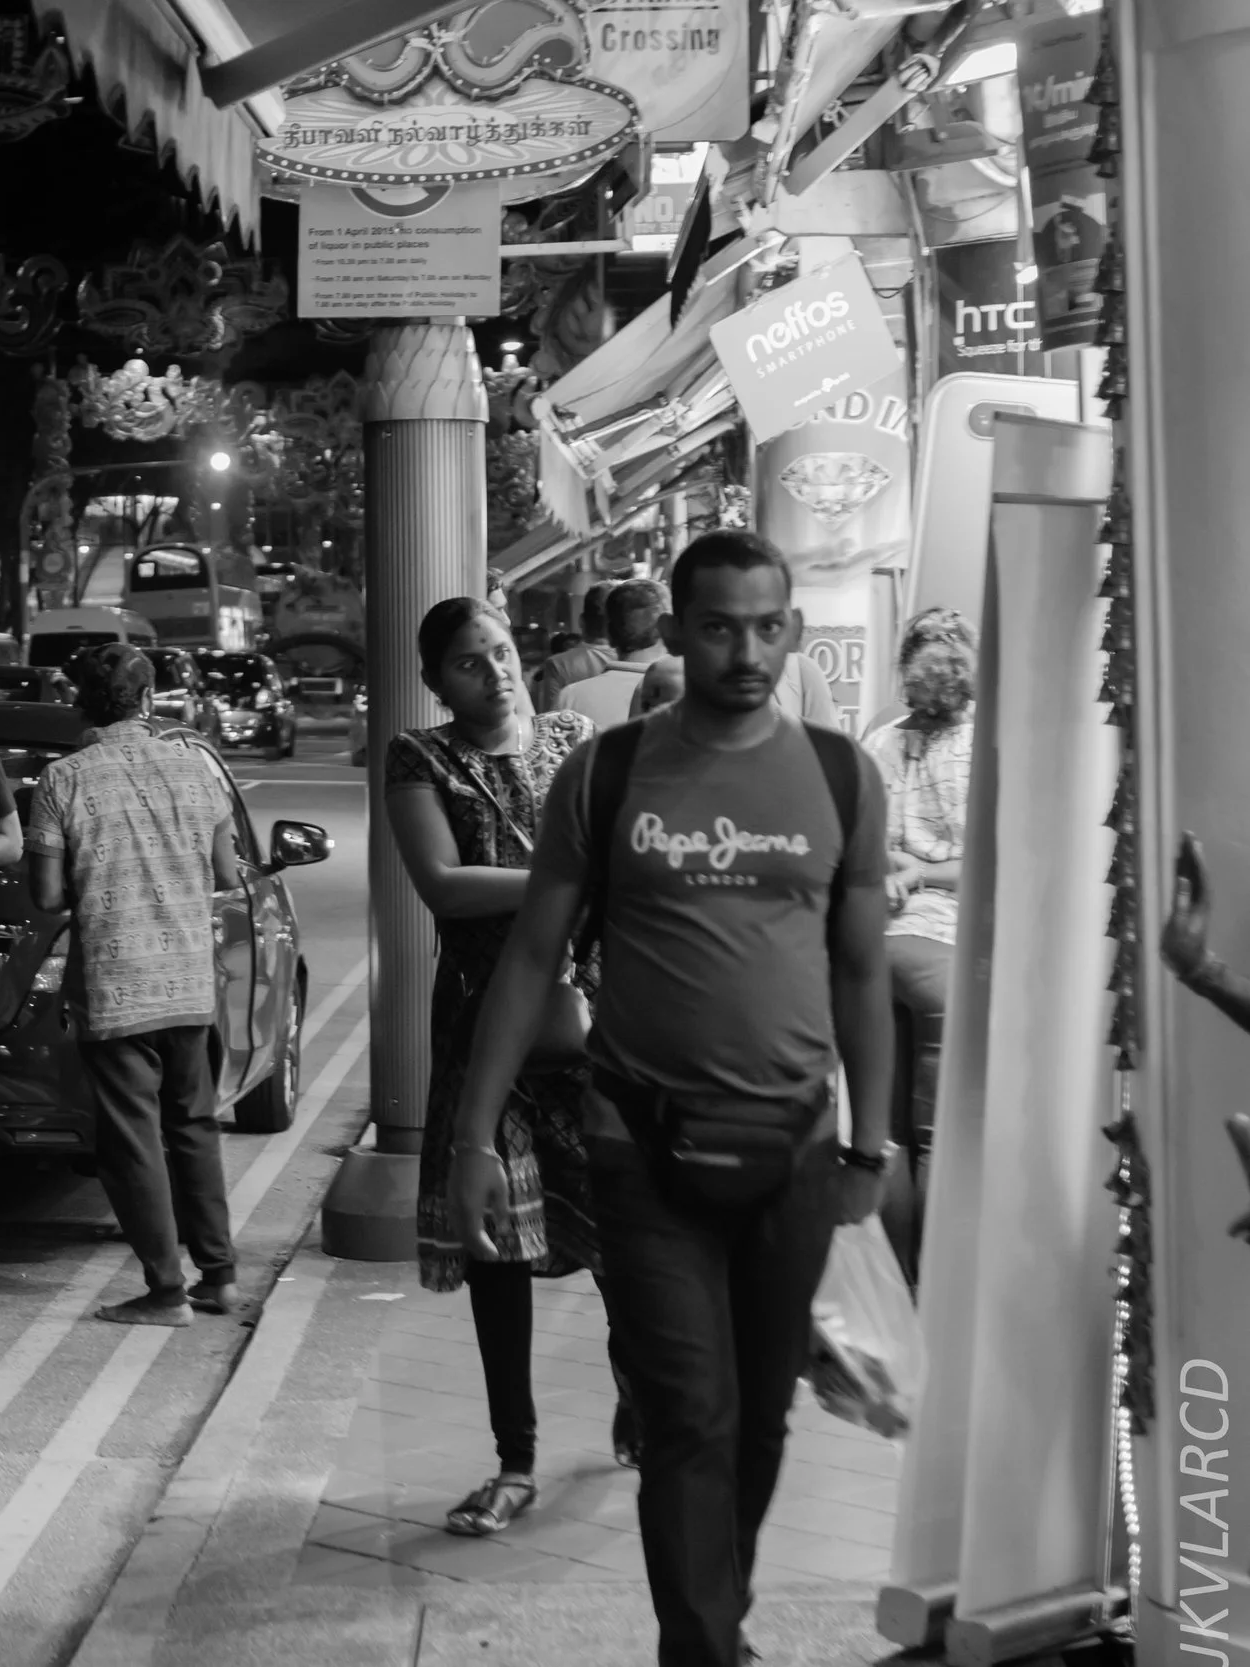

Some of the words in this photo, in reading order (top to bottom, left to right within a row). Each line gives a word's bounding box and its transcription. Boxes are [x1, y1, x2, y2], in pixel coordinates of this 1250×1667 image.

[601, 23, 721, 55] Crossing
[308, 227, 335, 237] From
[337, 227, 343, 236] 1
[345, 226, 369, 238] April
[415, 226, 482, 236] consumption
[308, 241, 318, 250] of
[363, 240, 395, 251] public
[397, 240, 430, 250] places
[746, 291, 850, 363] neffos
[755, 318, 857, 379] SMARTPHONE
[630, 811, 713, 870] Pepe
[708, 815, 812, 871] Jeans
[684, 872, 759, 886] LONDON
